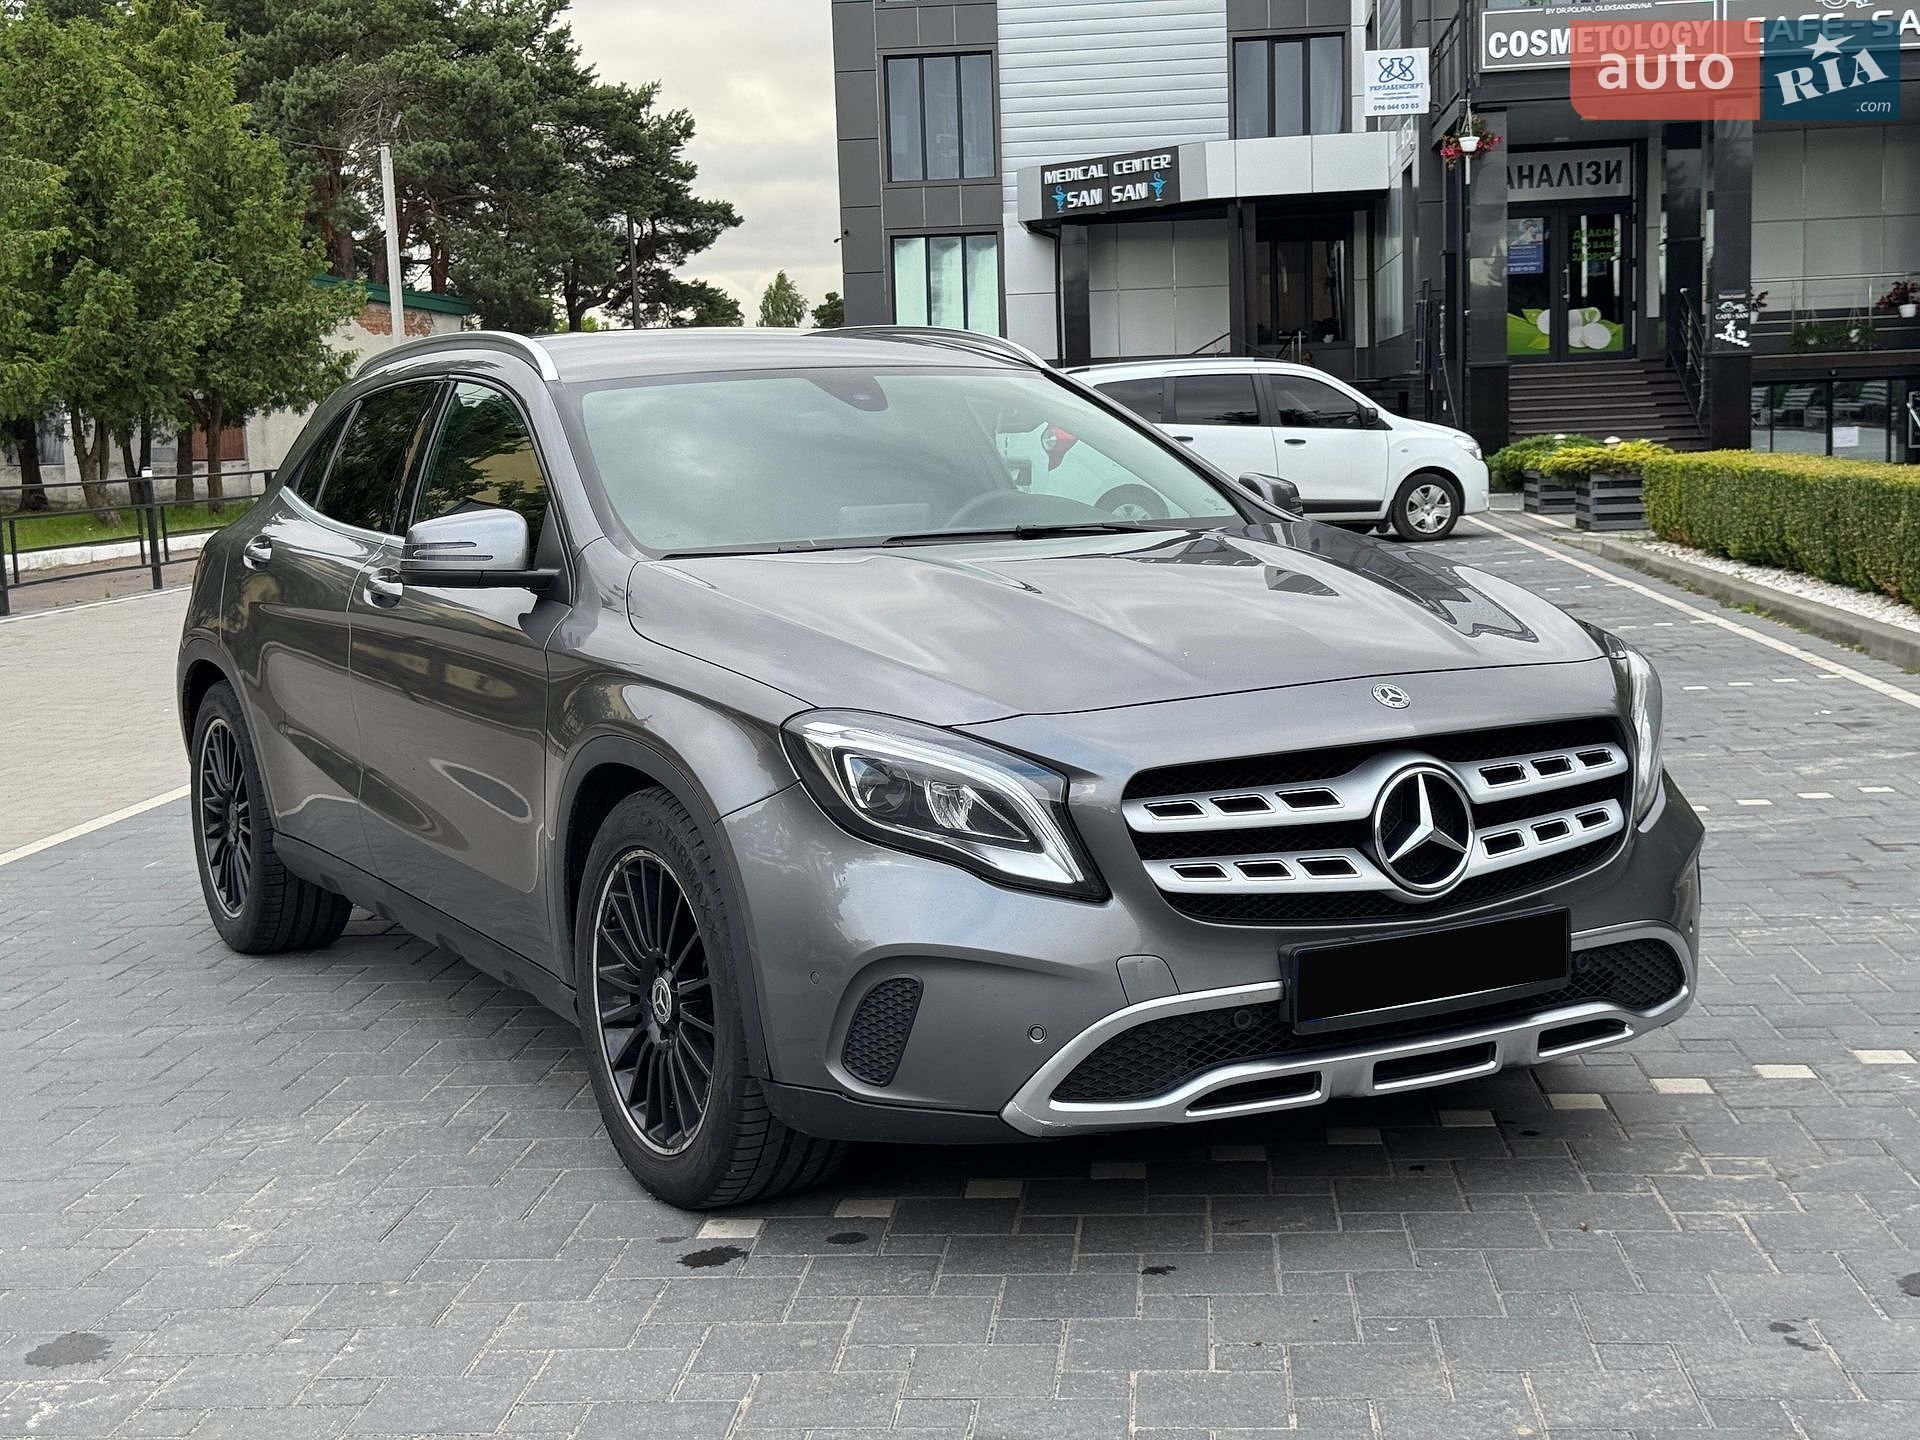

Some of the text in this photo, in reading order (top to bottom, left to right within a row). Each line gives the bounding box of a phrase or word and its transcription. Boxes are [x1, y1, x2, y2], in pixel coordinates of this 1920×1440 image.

[1488, 20, 1712, 59] COSMETOLOGY
[1373, 103, 1386, 111] 096
[1044, 154, 1171, 185] MEDICAL CENTER
[1066, 182, 1149, 209] SAN SAN
